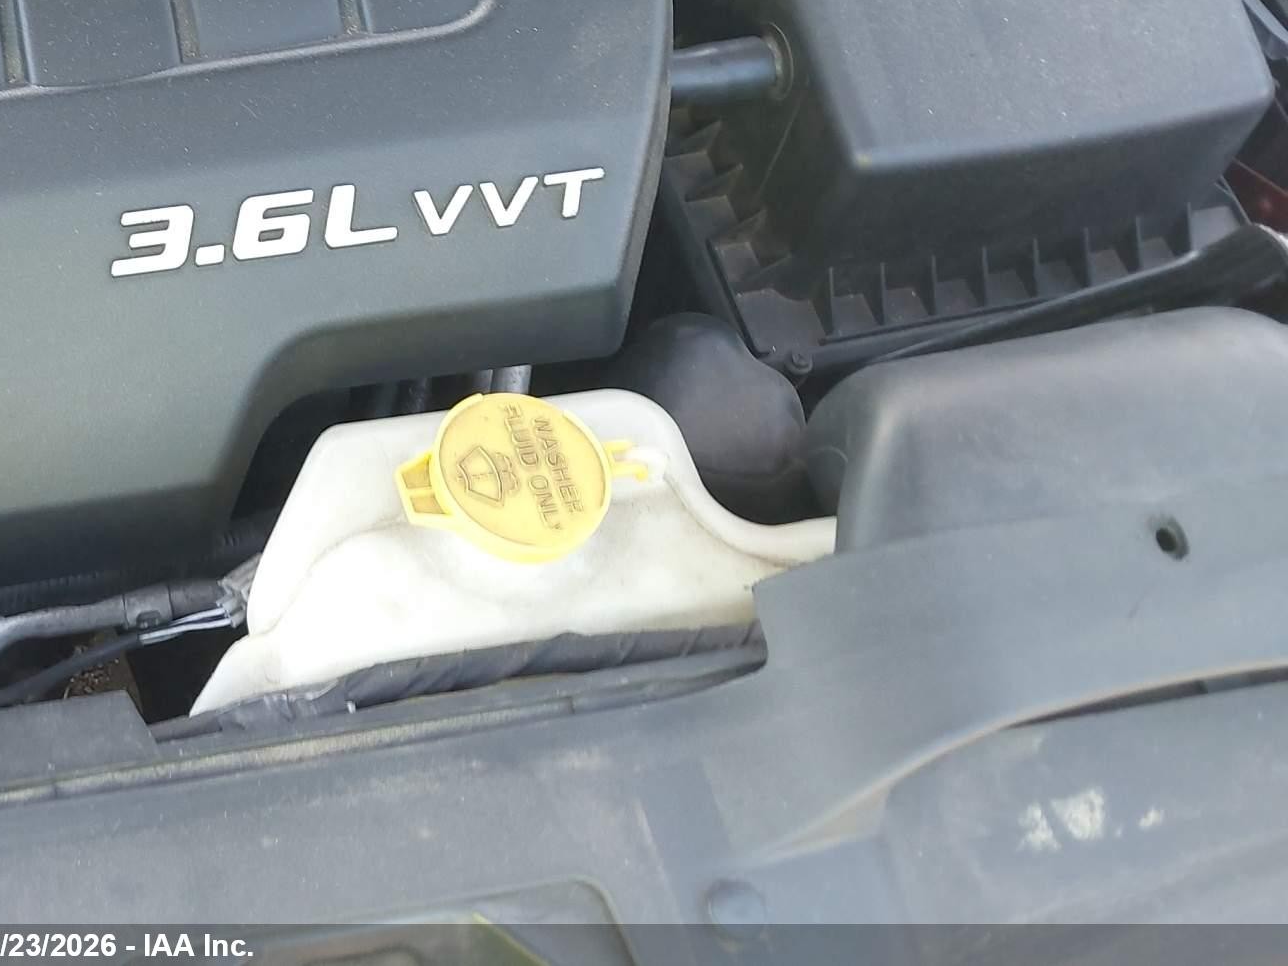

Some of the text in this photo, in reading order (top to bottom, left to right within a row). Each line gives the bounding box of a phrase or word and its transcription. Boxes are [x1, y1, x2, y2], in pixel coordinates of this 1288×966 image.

[110, 166, 606, 277] 3.6L VVT
[502, 404, 564, 531] FLUID ONLY
[533, 417, 585, 514] WASHER
